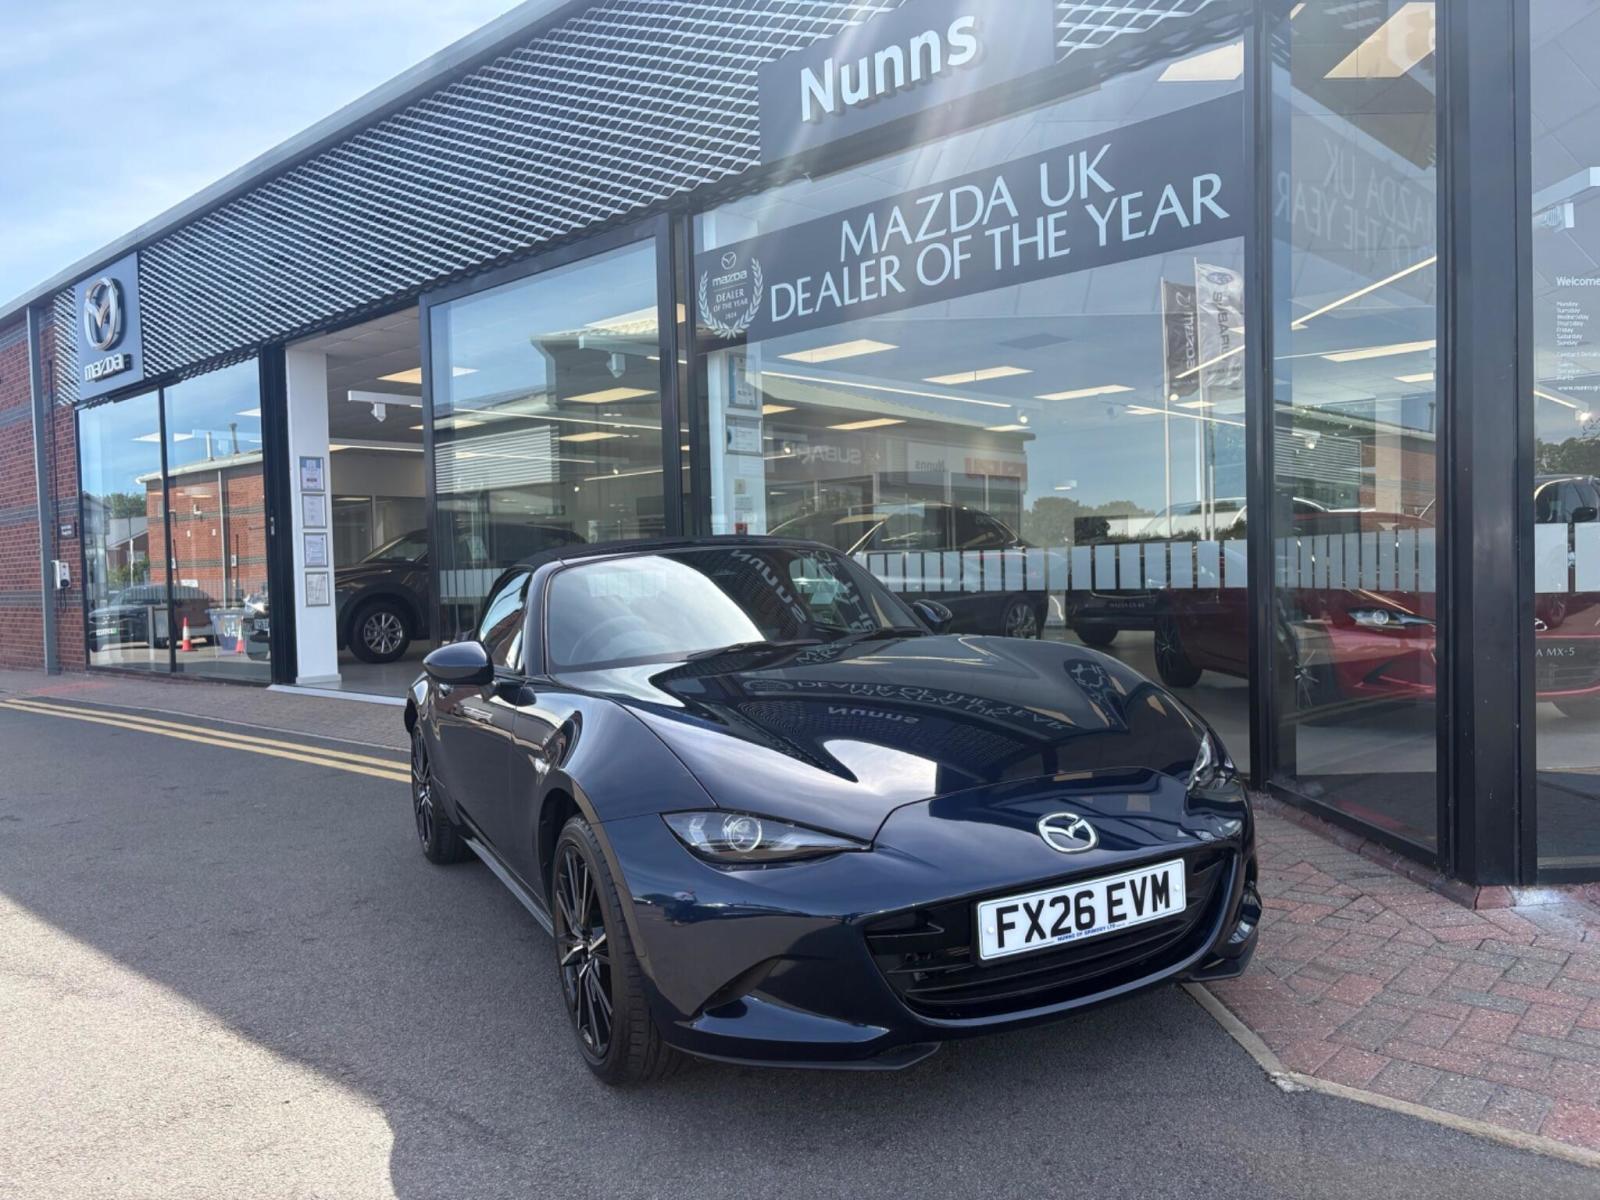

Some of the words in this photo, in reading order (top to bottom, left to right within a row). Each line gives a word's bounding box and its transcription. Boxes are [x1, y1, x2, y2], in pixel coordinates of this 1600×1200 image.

[800, 15, 977, 122] Nunns
[840, 176, 1019, 262] MAZDA
[1040, 144, 1115, 207] UK
[770, 255, 906, 322] DEALER
[916, 235, 972, 286] OF
[985, 210, 1071, 271] THE
[1084, 173, 1230, 247] YEAR
[713, 304, 720, 312] OF
[722, 302, 732, 310] THE
[733, 298, 748, 307] YEAR
[716, 288, 744, 302] DEALER
[1546, 647, 1575, 657] MX-5
[996, 890, 1095, 948] FX26
[1106, 870, 1170, 924] EVM
